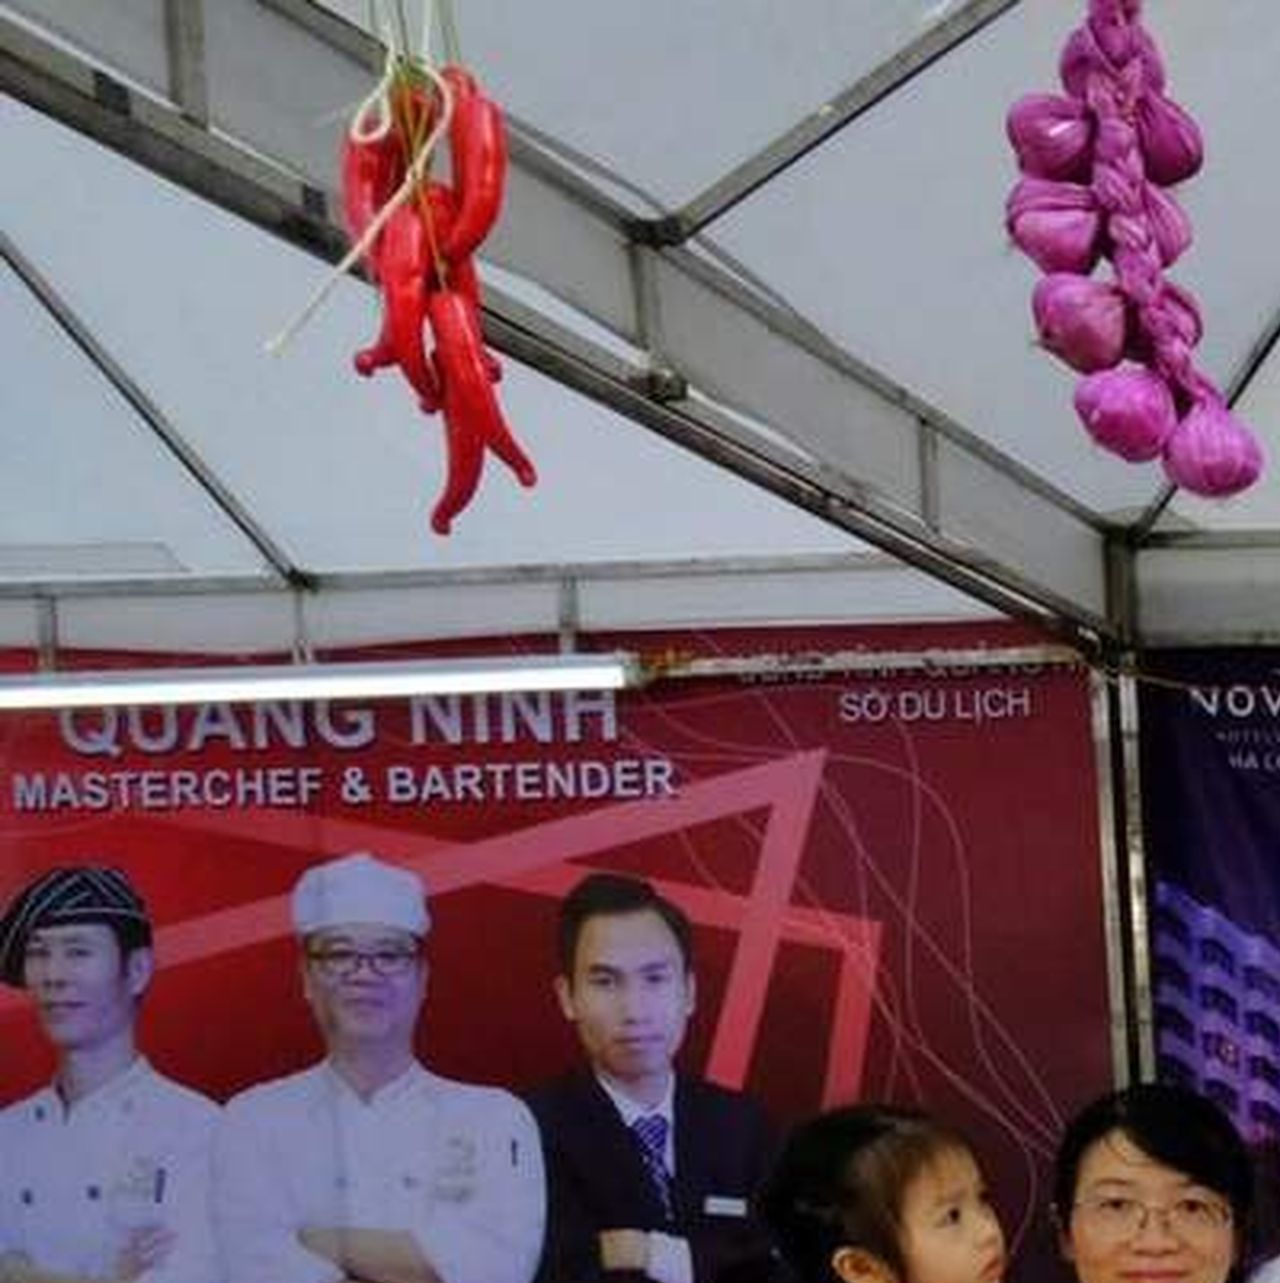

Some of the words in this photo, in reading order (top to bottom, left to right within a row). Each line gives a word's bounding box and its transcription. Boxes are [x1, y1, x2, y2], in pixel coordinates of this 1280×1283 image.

[899, 690, 945, 720] DU
[13, 767, 323, 809] MASTERCHEF
[341, 765, 371, 803] &
[387, 758, 675, 803] BARTENDER
